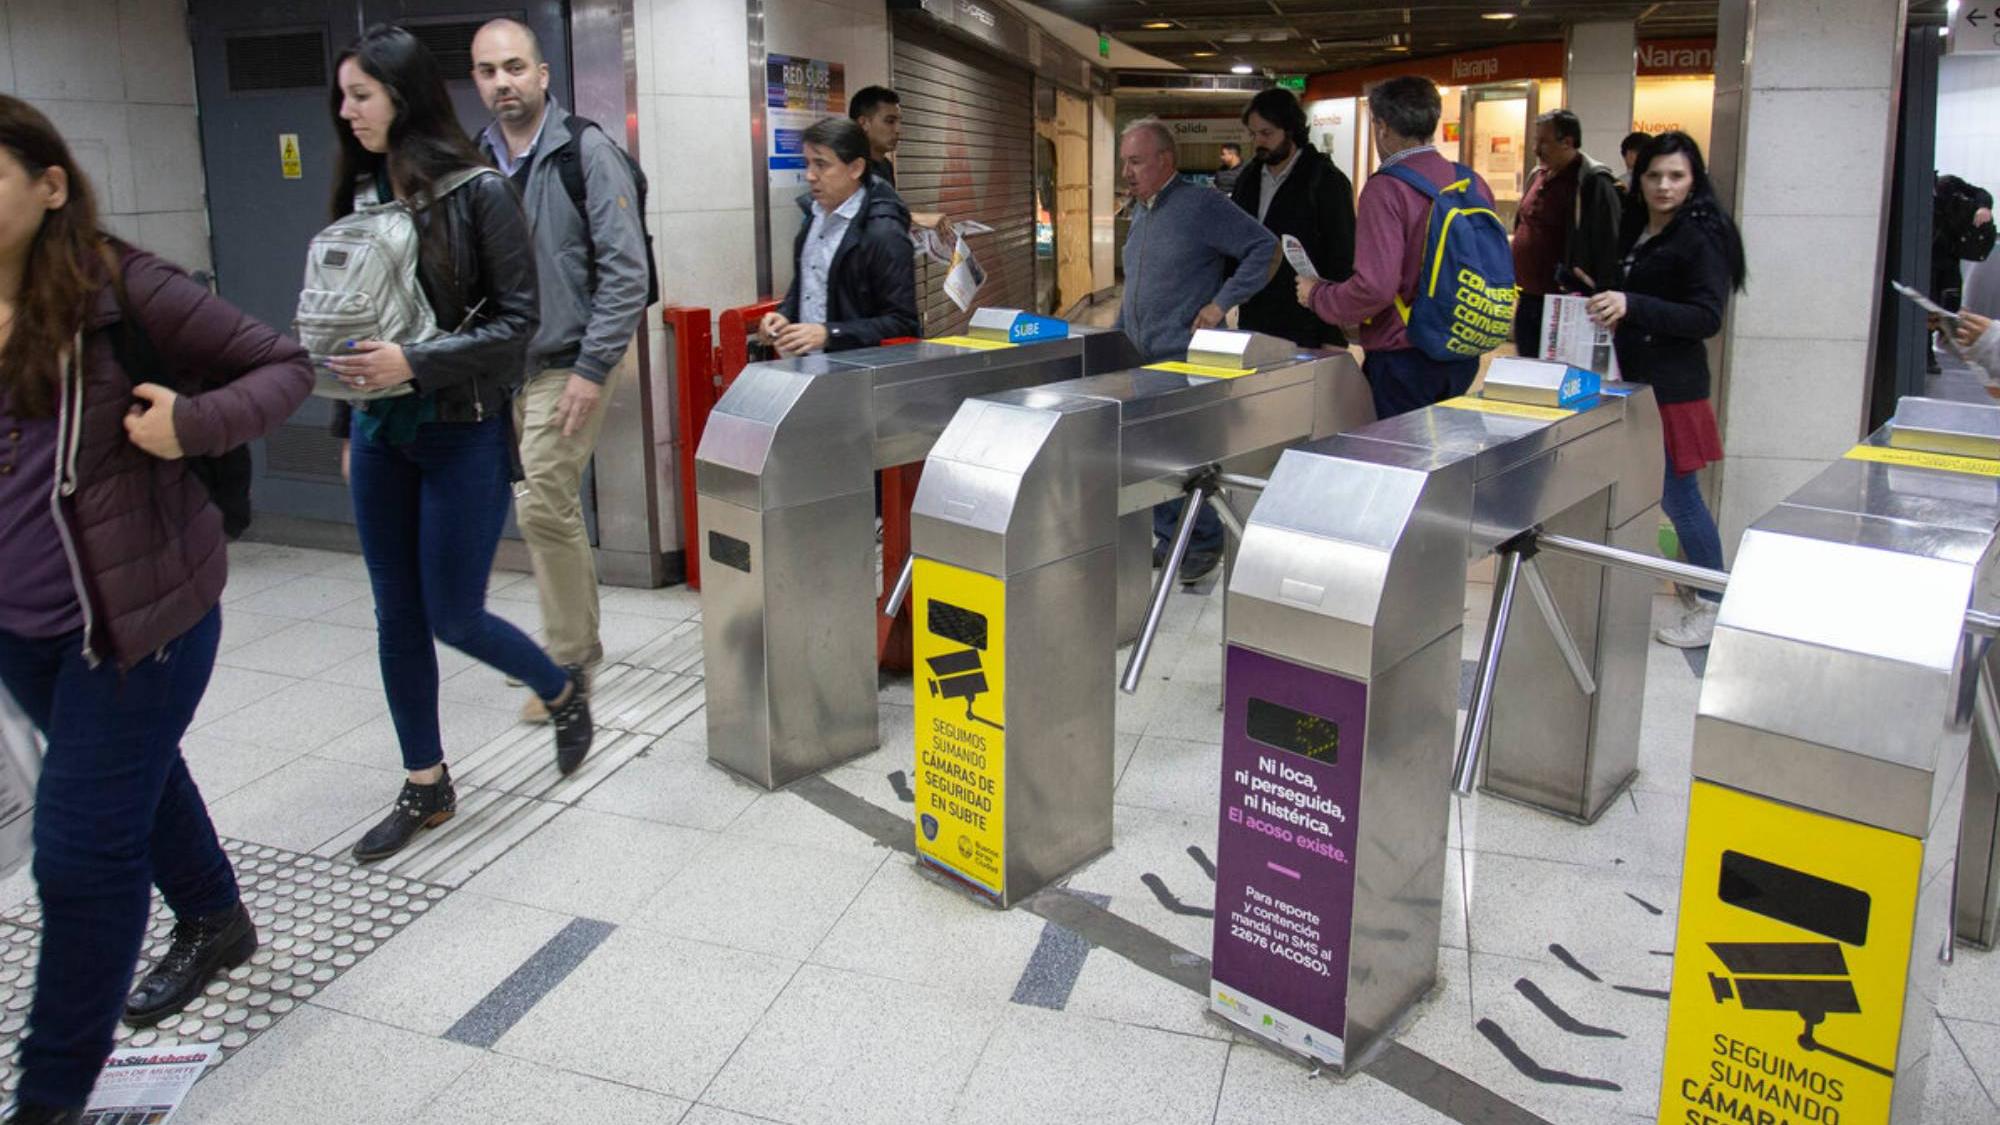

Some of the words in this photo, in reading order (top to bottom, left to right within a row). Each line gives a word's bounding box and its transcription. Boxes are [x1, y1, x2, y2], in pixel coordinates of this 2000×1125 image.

[783, 64, 803, 86] RED
[1452, 58, 1498, 80] Naranja
[1174, 122, 1208, 134] Salida
[1014, 321, 1040, 337] SUBE
[1561, 377, 1582, 400] SUBE
[933, 717, 986, 751] SEGUIMOS
[933, 735, 986, 770] SUMANDO
[922, 748, 976, 787] CÁMARAS
[978, 775, 995, 796] DE
[925, 770, 991, 813] SEGURIDAD
[1259, 756, 1276, 775] Ni
[1280, 763, 1317, 792] loca,
[931, 792, 947, 812] EN
[950, 804, 986, 831] SUBTE
[1235, 770, 1248, 786] ni
[1251, 776, 1346, 823] perseguida,
[1244, 794, 1258, 809] ni
[1262, 797, 1333, 837] histérica.
[1228, 806, 1243, 824] El
[1246, 815, 1293, 843] acoso
[1296, 834, 1348, 863] existe.
[1244, 901, 1251, 913] y
[1253, 905, 1320, 941] contención
[1246, 886, 1272, 907] Para
[1274, 901, 1320, 926] reporte
[1231, 911, 1272, 937] mandá
[1273, 929, 1289, 943] un
[1291, 935, 1318, 955] SMS
[1320, 949, 1332, 961] al
[1231, 925, 1268, 949] 22676
[1270, 941, 1331, 977] (ACOSO).
[1713, 1033, 1844, 1102] SEGUIMOS
[1710, 1060, 1840, 1125] SUMANDO
